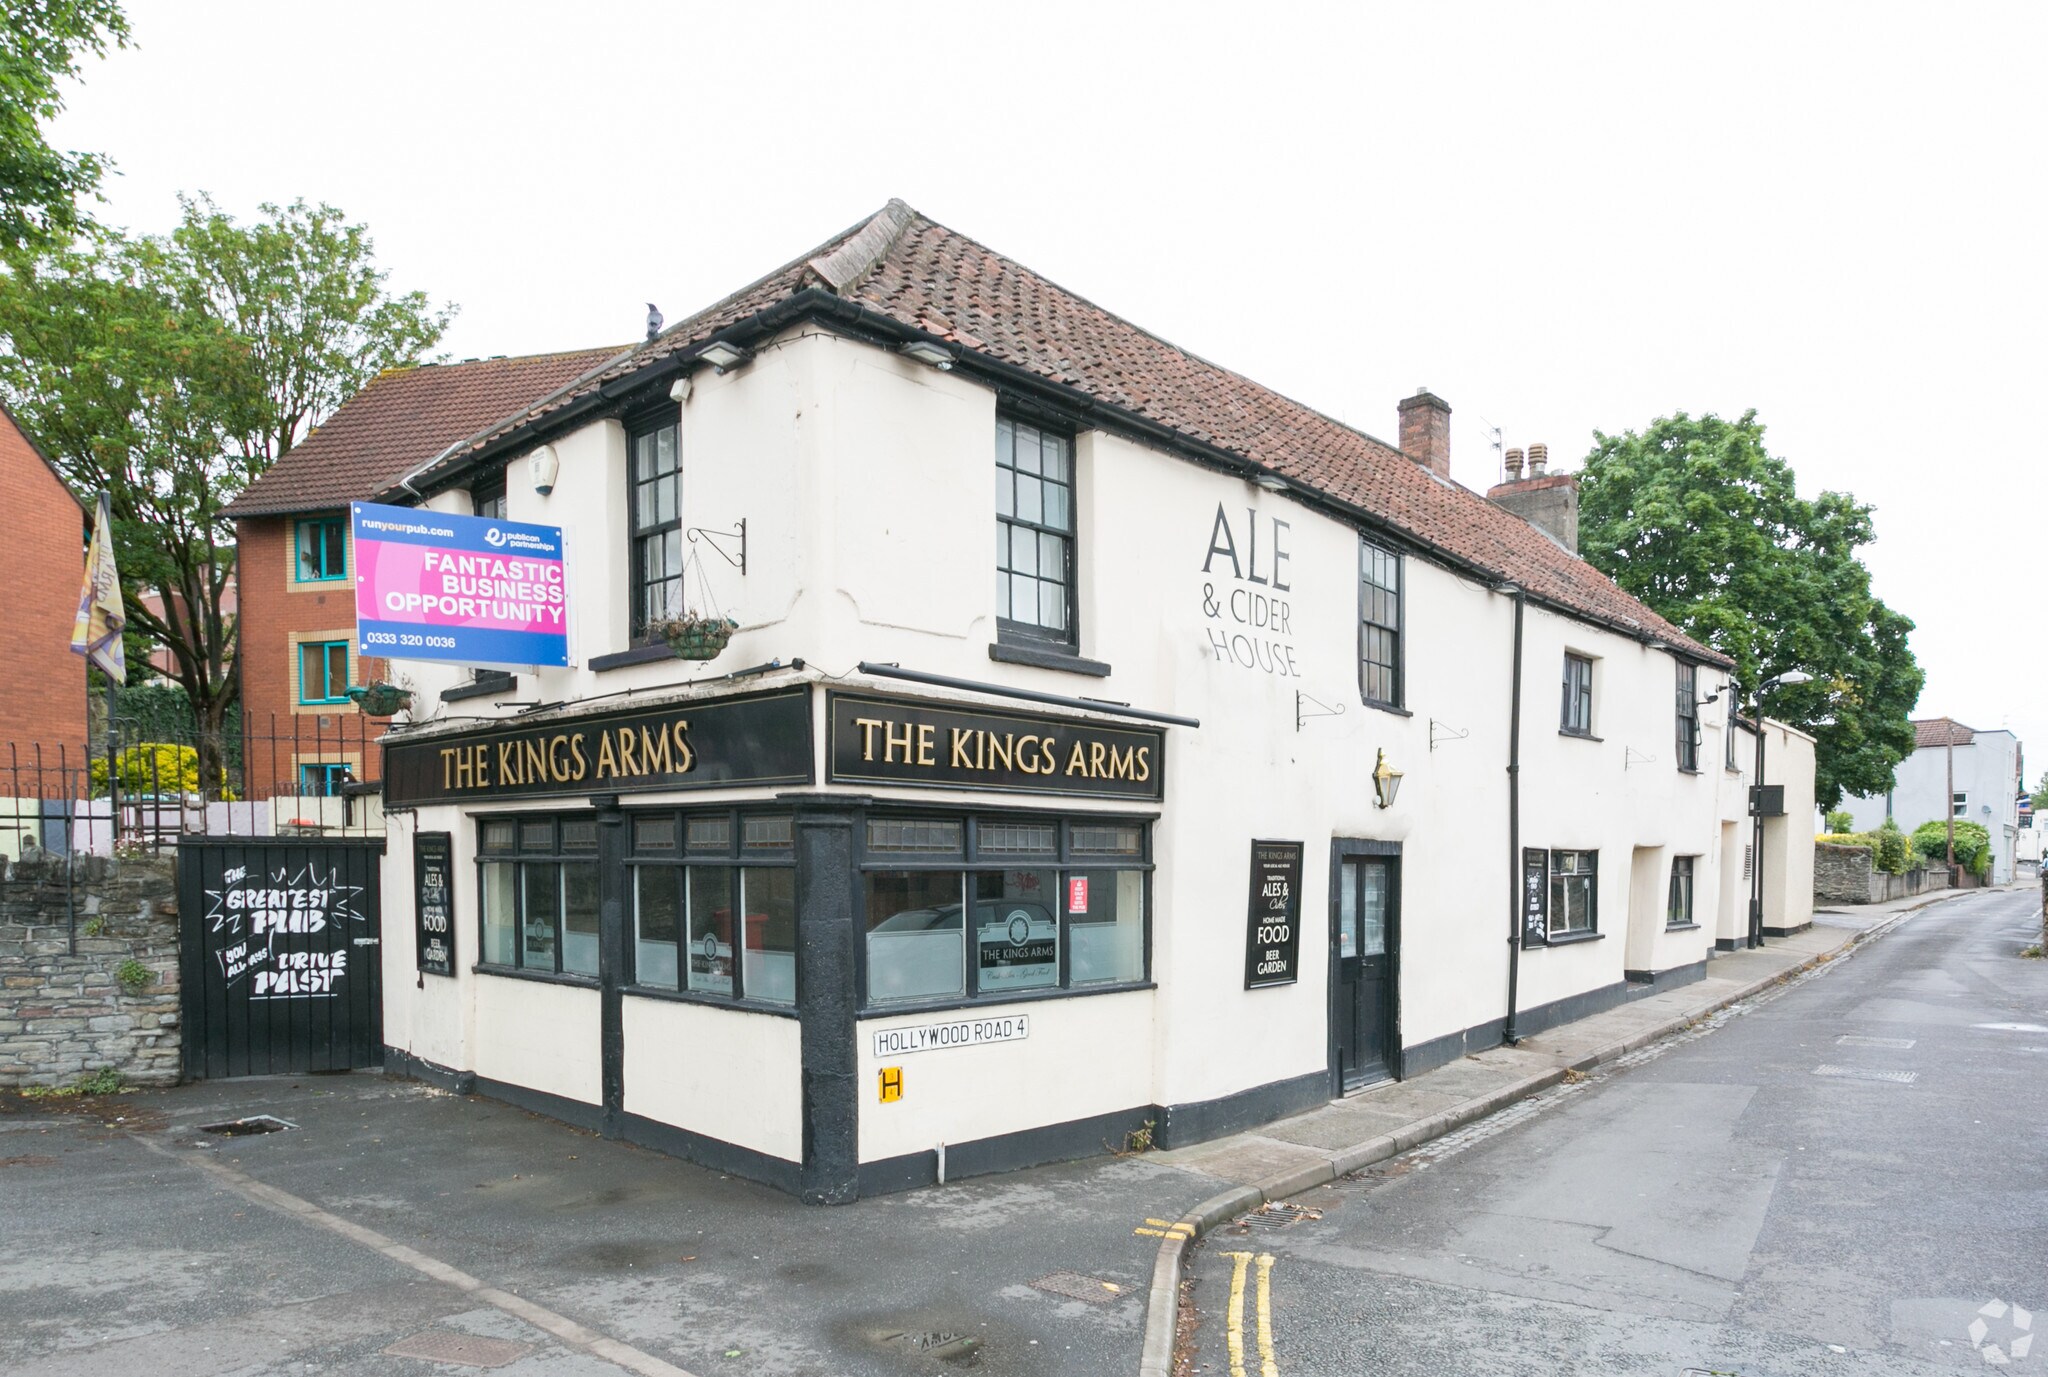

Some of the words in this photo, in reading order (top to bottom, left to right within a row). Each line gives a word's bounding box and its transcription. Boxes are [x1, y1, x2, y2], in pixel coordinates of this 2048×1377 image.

[361, 519, 454, 537] runyourpub.com
[507, 533, 540, 543] publican
[510, 540, 555, 551] partnerships
[1201, 500, 1291, 592] ALE
[424, 552, 562, 584] FANTASTIC
[442, 575, 563, 604] BUSINESS
[385, 592, 564, 624] OPPORTUNITY
[1203, 582, 1222, 619] &
[1230, 588, 1292, 636] CIDER
[367, 632, 397, 645] 0333
[400, 633, 423, 646] 320
[426, 635, 456, 648] 0036
[1206, 627, 1301, 678] HOUSE
[440, 744, 490, 790] THE
[498, 733, 587, 786] KINGS
[596, 720, 694, 779] ARMS
[856, 718, 936, 766] THE
[951, 727, 1056, 775] KINGS
[1065, 740, 1150, 782] ARMS
[1257, 851, 1268, 860] THE
[224, 866, 247, 884] THE
[226, 888, 337, 910] GREATEST
[1262, 882, 1281, 897] ALES
[1282, 882, 1289, 896] &
[251, 909, 327, 934] PUB
[424, 914, 447, 932] FOOD
[1257, 925, 1290, 945] FOOD
[226, 942, 247, 963] YOU
[278, 950, 347, 969] DRIVE
[983, 949, 1000, 961] THE
[1003, 947, 1029, 959] KINGS
[1031, 946, 1054, 957] ARMS
[1265, 949, 1280, 961] BEER
[1257, 960, 1287, 975] GARDEN
[254, 969, 345, 994] PAST
[879, 1024, 969, 1053] HOLLYWOOD
[974, 1020, 1013, 1041] ROAD
[1017, 1019, 1025, 1036] 4
[882, 1069, 900, 1099] H
